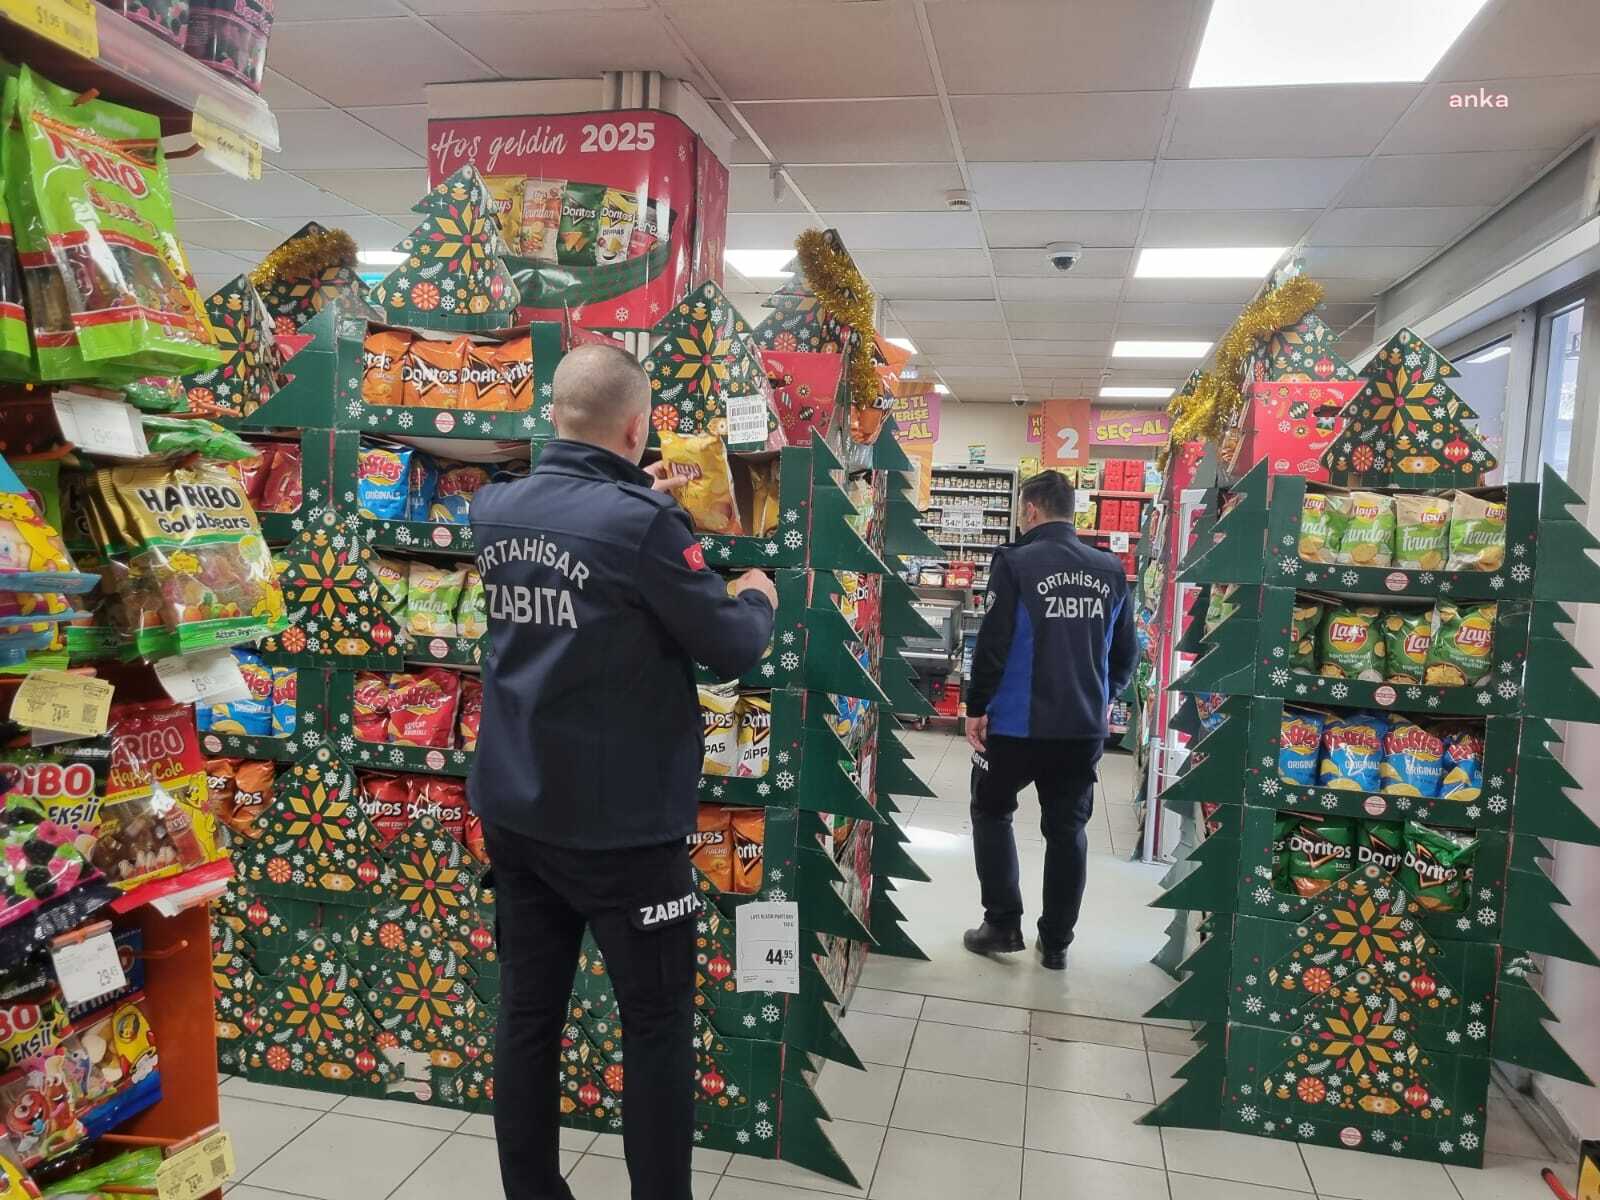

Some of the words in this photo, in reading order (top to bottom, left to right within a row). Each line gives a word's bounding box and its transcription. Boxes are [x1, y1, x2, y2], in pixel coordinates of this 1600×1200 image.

[431, 129, 482, 174] Hoş
[487, 126, 567, 172] geldin
[580, 122, 655, 152] 2025
[562, 206, 597, 219] Doritos
[601, 206, 634, 222] Doritos
[1057, 427, 1079, 459] 2
[1096, 419, 1166, 442] SEÇ-AL
[136, 483, 242, 514] HARIBO
[158, 510, 251, 534] Goldbears
[475, 534, 590, 590] ORTAHİSAR
[1037, 570, 1110, 598] ORTAHİSAR
[484, 584, 578, 629] ZABITA
[1045, 596, 1104, 619] ZABITA
[152, 757, 184, 780] Cola
[1290, 836, 1351, 859] Doritos
[640, 891, 702, 925] ZABITA
